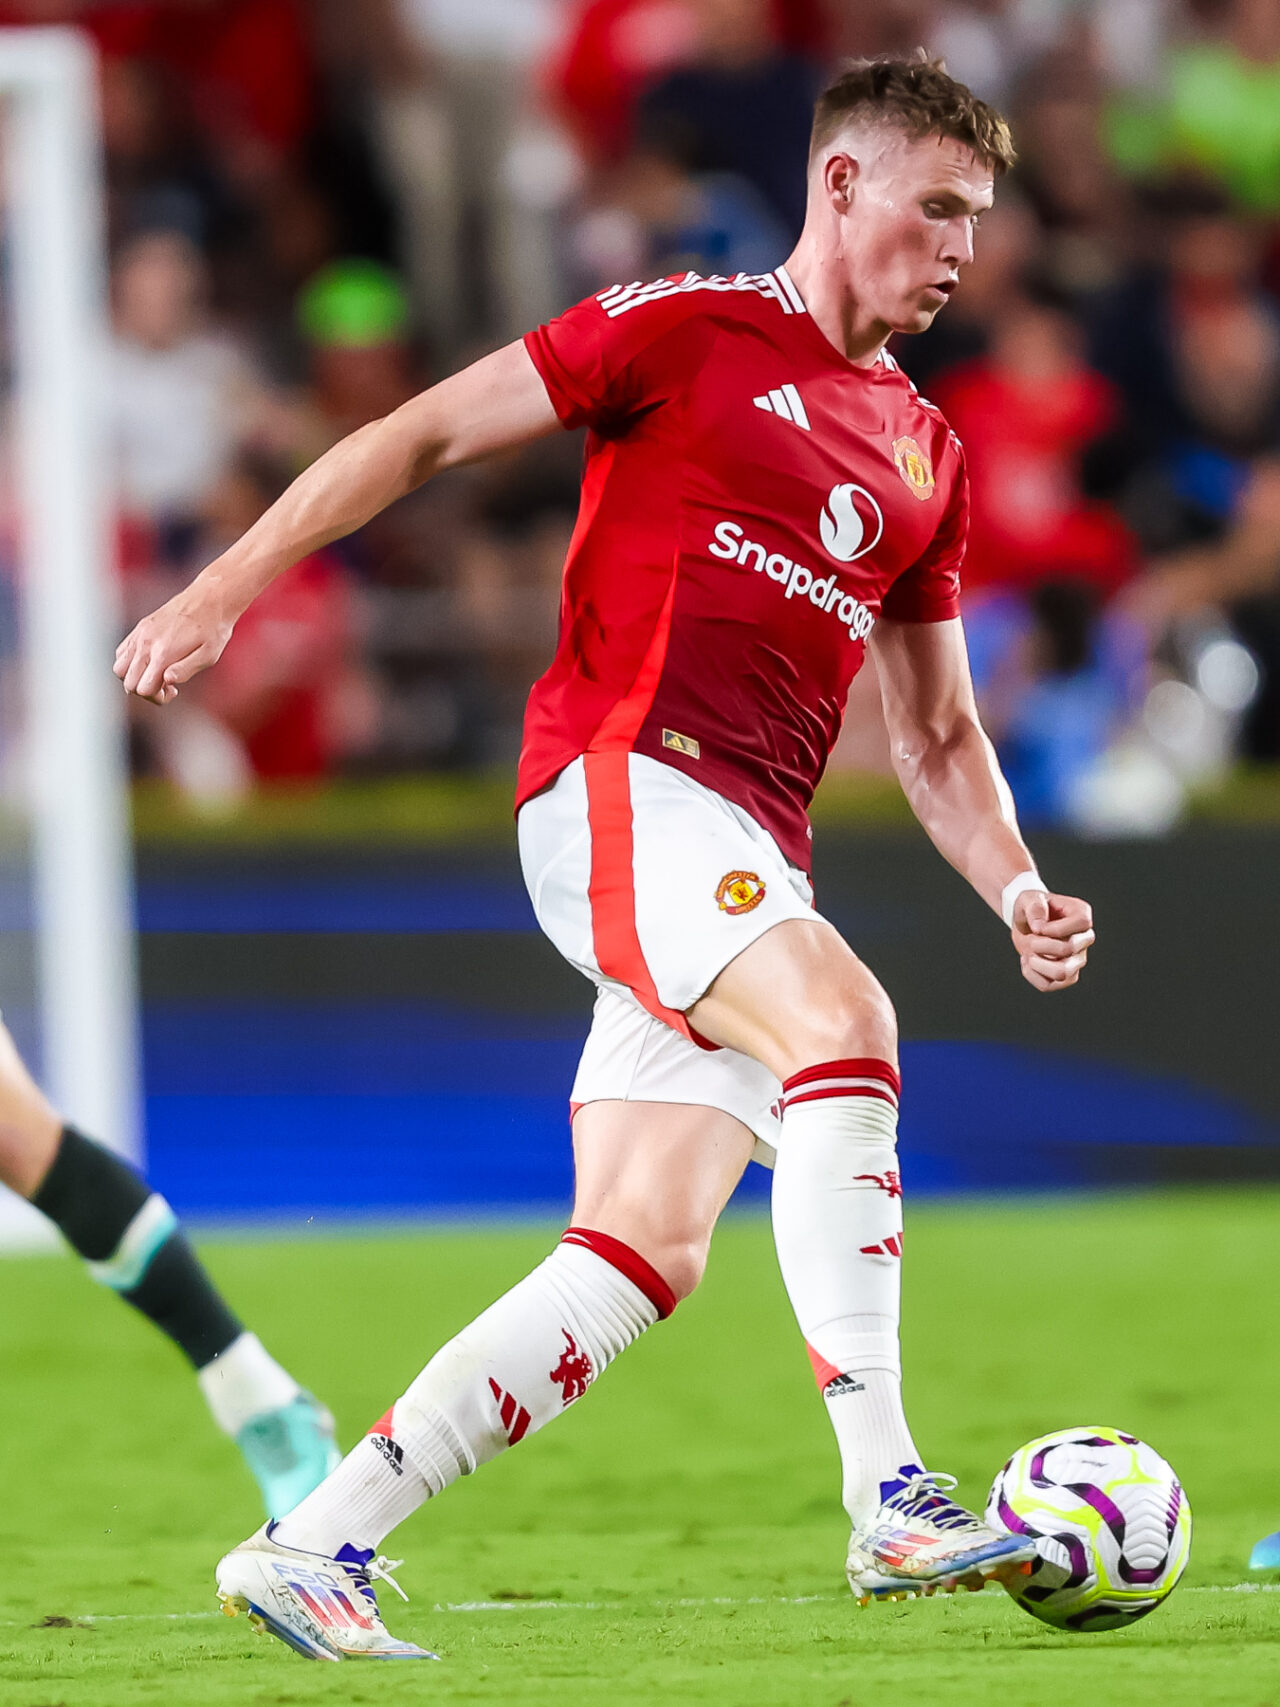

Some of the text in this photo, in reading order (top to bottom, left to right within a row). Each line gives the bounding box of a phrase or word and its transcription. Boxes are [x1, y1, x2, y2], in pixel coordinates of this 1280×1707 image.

[708, 521, 875, 641] Snapdrago
[826, 1383, 866, 1398] adidas
[371, 1437, 403, 1476] adidas
[271, 1562, 339, 1588] F50
